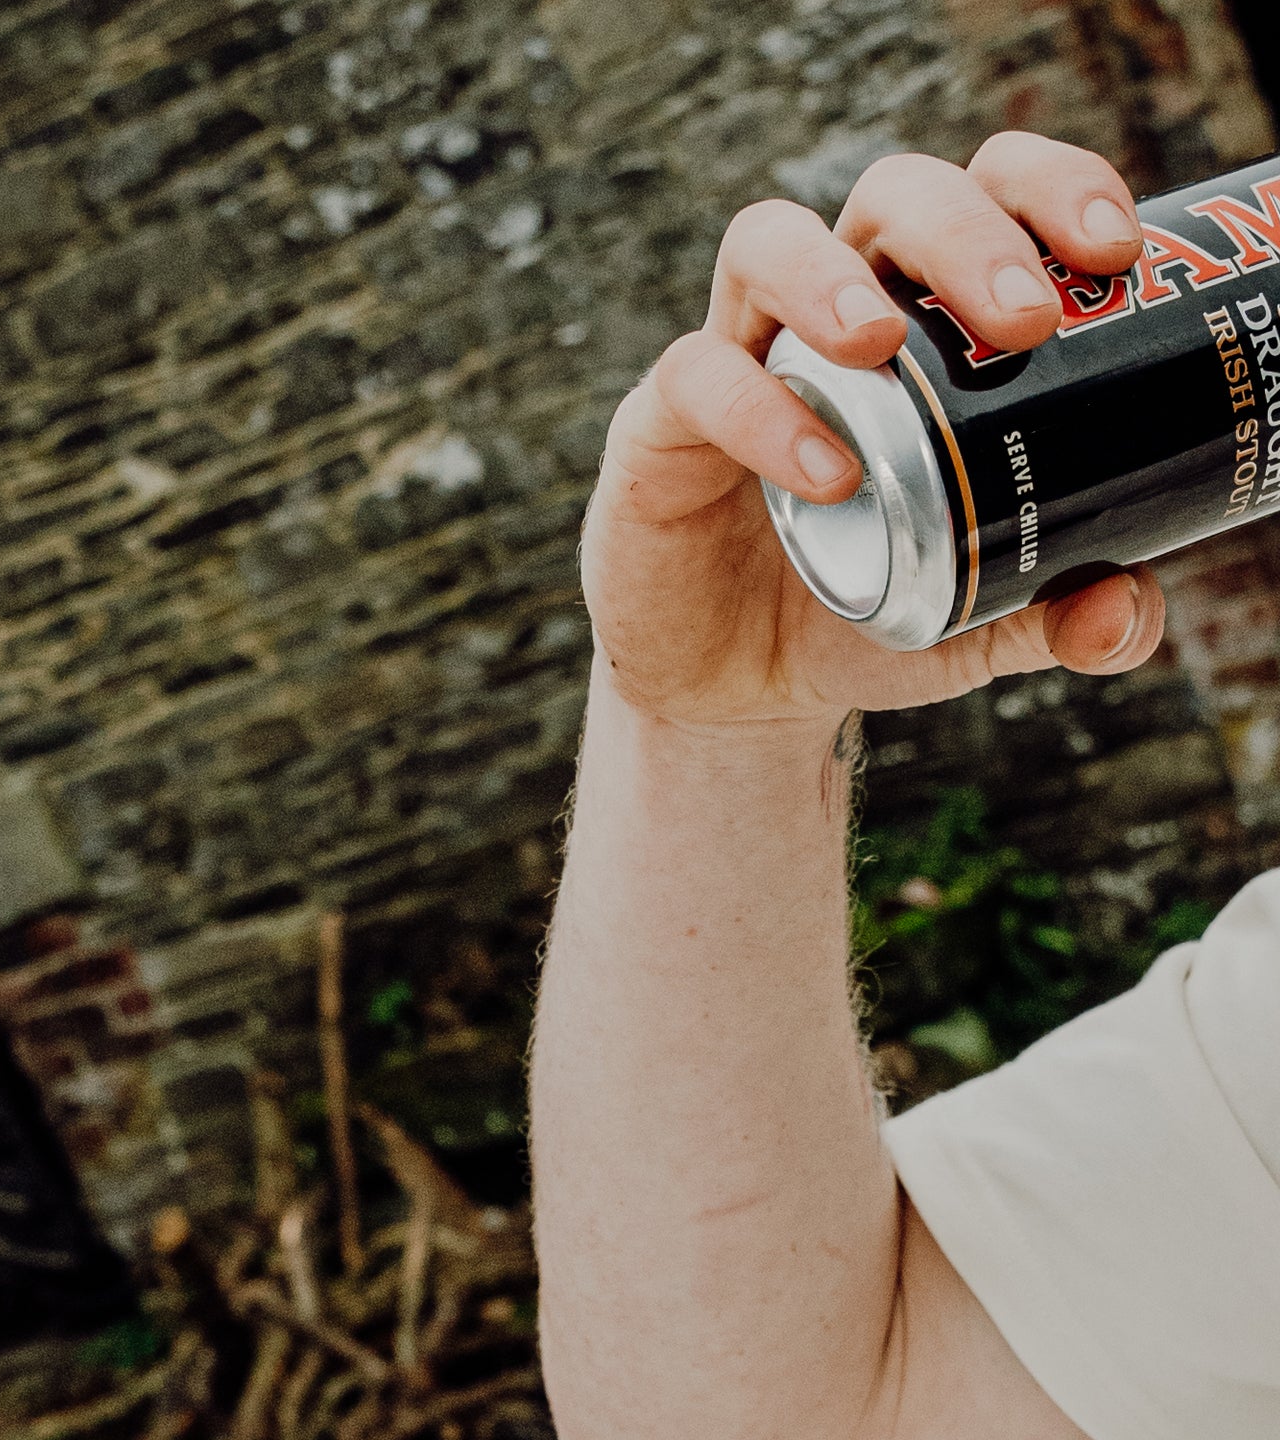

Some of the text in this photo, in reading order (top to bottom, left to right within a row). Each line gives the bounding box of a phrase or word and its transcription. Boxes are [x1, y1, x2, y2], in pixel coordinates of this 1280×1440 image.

[1203, 305, 1260, 518] IRISH STOUT
[1003, 430, 1038, 573] SERVE CHILLED
